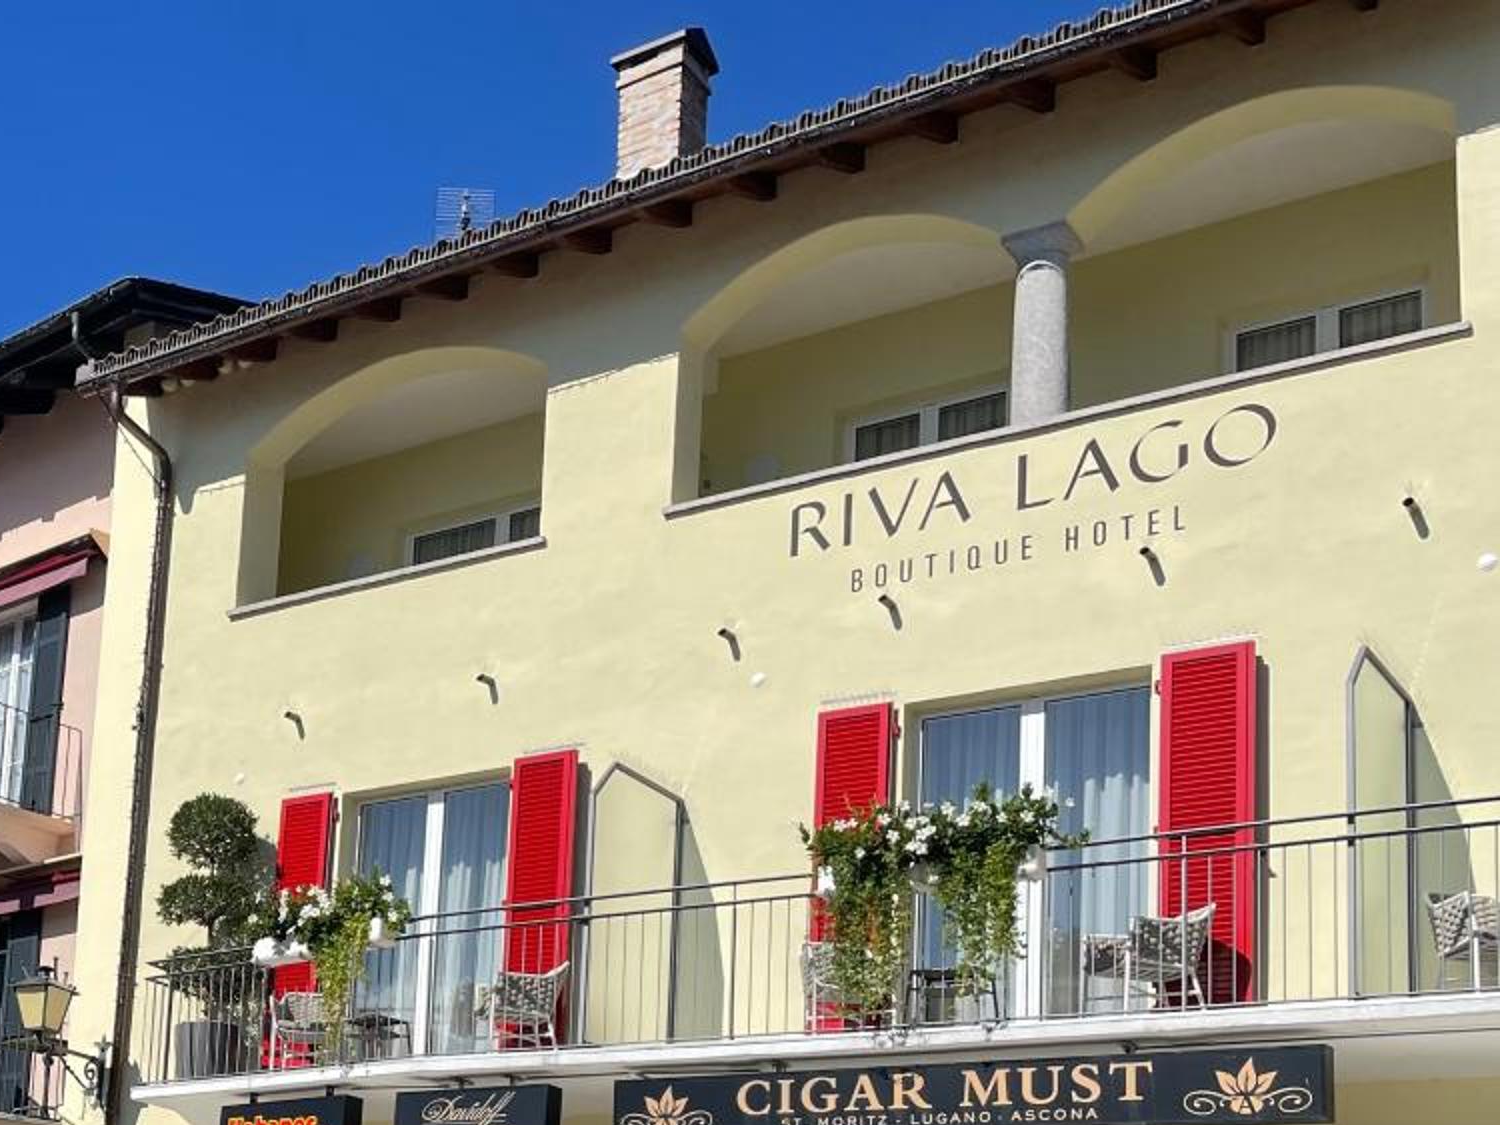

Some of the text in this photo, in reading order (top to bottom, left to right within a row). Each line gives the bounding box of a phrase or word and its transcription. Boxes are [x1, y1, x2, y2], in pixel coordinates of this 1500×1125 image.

[790, 403, 1277, 558] RIVA LAGO
[851, 505, 1186, 593] BOUTIQUE HOTEL
[736, 1060, 1154, 1116] CIGAR MUST
[910, 1111, 992, 1125] LUGANO
[1011, 1107, 1099, 1122] ASCONA
